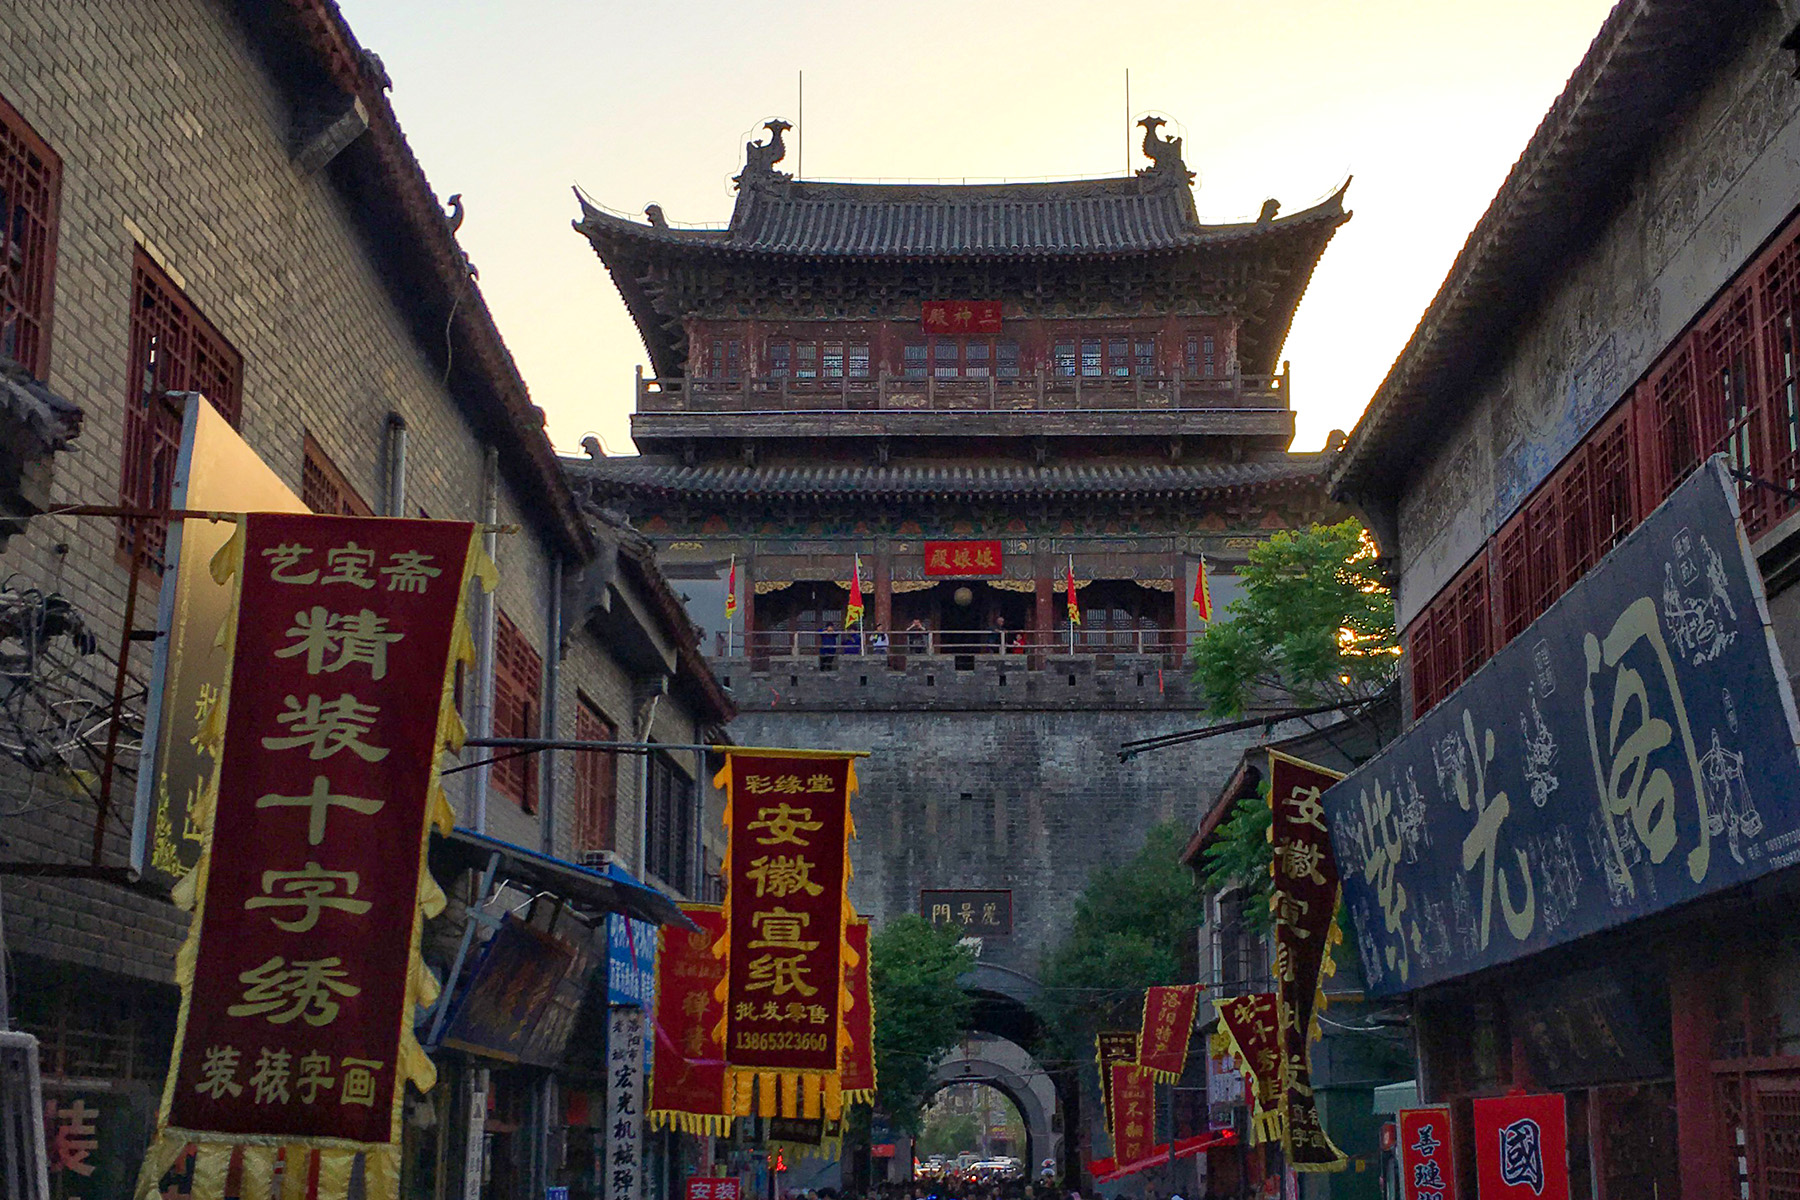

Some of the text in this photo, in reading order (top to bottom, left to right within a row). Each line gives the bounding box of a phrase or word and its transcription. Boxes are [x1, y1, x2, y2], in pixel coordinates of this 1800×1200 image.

[262, 541, 442, 594] 艺宝斋
[744, 773, 835, 794] 彩缘堂
[228, 606, 404, 1027] 精装十字绣
[745, 803, 824, 997] 安徽宣纸
[735, 1001, 829, 1025] 批发零售
[735, 1031, 827, 1051] 13865323660
[195, 1046, 384, 1107] 装裱字画
[612, 1064, 638, 1200] 宏光机械弹
